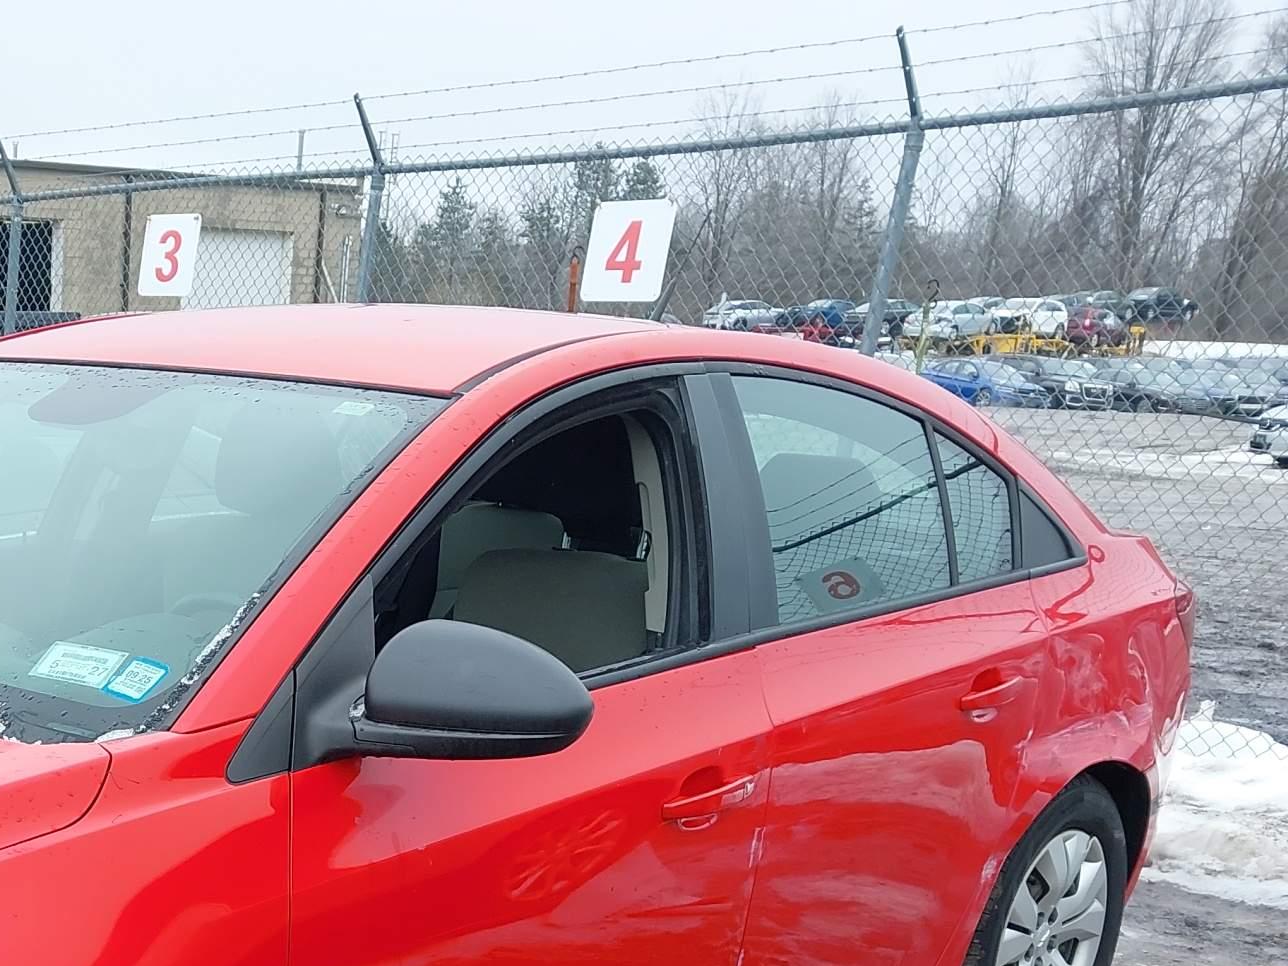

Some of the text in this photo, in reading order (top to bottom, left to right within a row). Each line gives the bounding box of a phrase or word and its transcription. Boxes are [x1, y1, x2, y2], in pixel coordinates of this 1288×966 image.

[155, 230, 182, 282] 3
[605, 220, 642, 283] 4
[88, 665, 109, 677] 27
